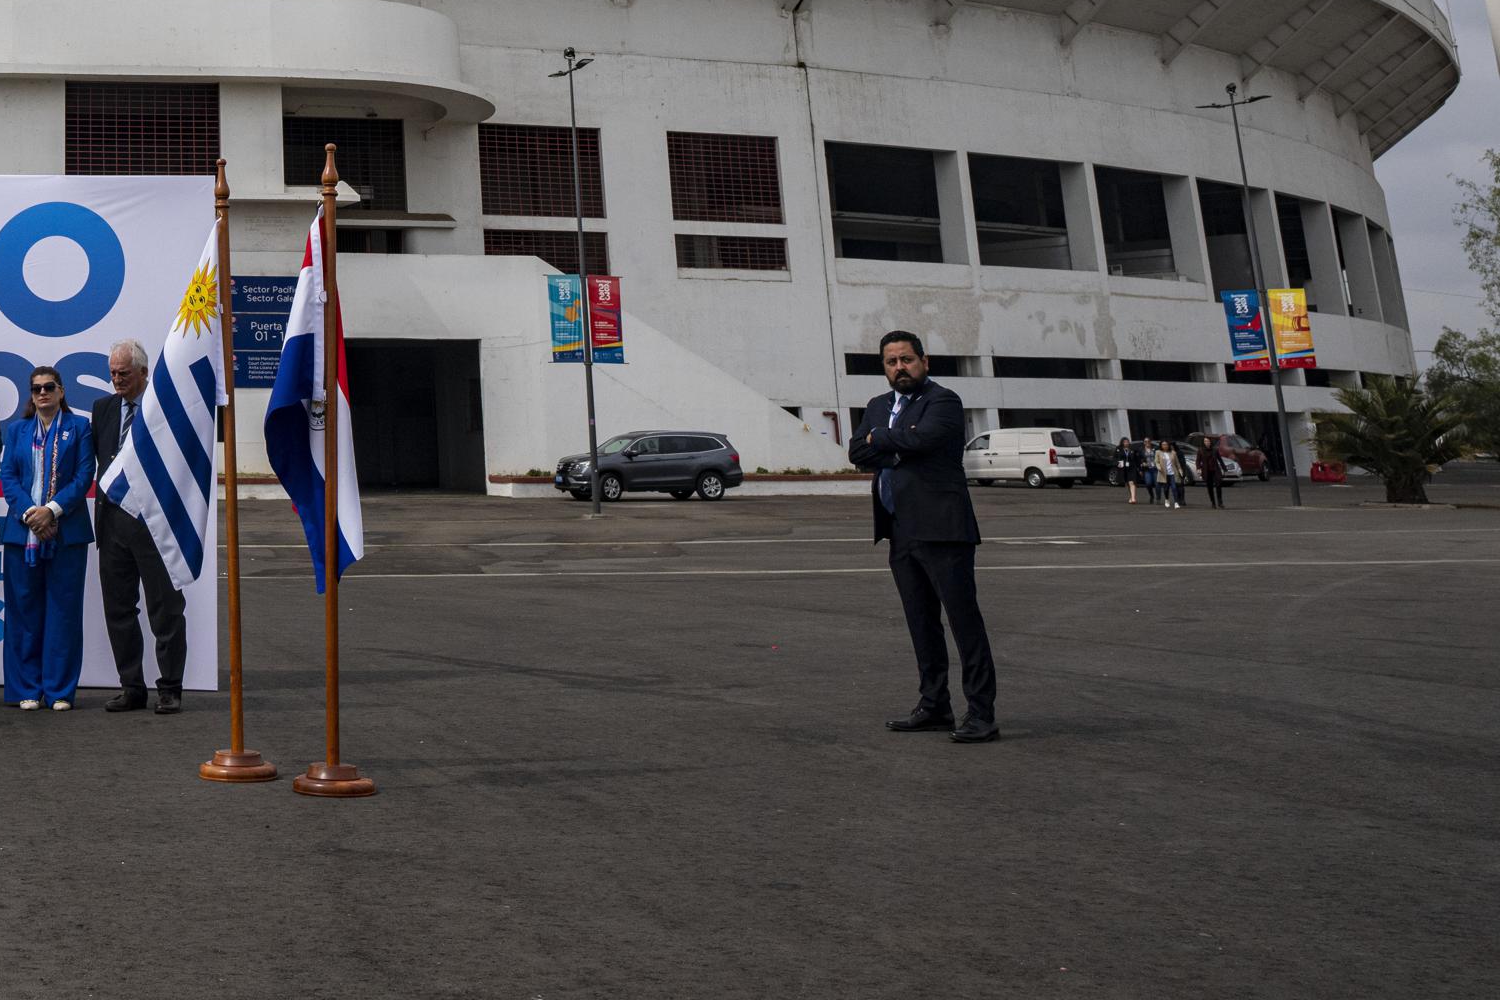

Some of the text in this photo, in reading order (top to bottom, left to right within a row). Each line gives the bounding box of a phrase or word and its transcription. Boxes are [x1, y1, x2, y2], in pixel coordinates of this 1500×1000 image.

[243, 285, 270, 293] Sector
[246, 294, 294, 302] Sector Gale
[250, 321, 283, 331] Puerta
[254, 331, 268, 342] 01
